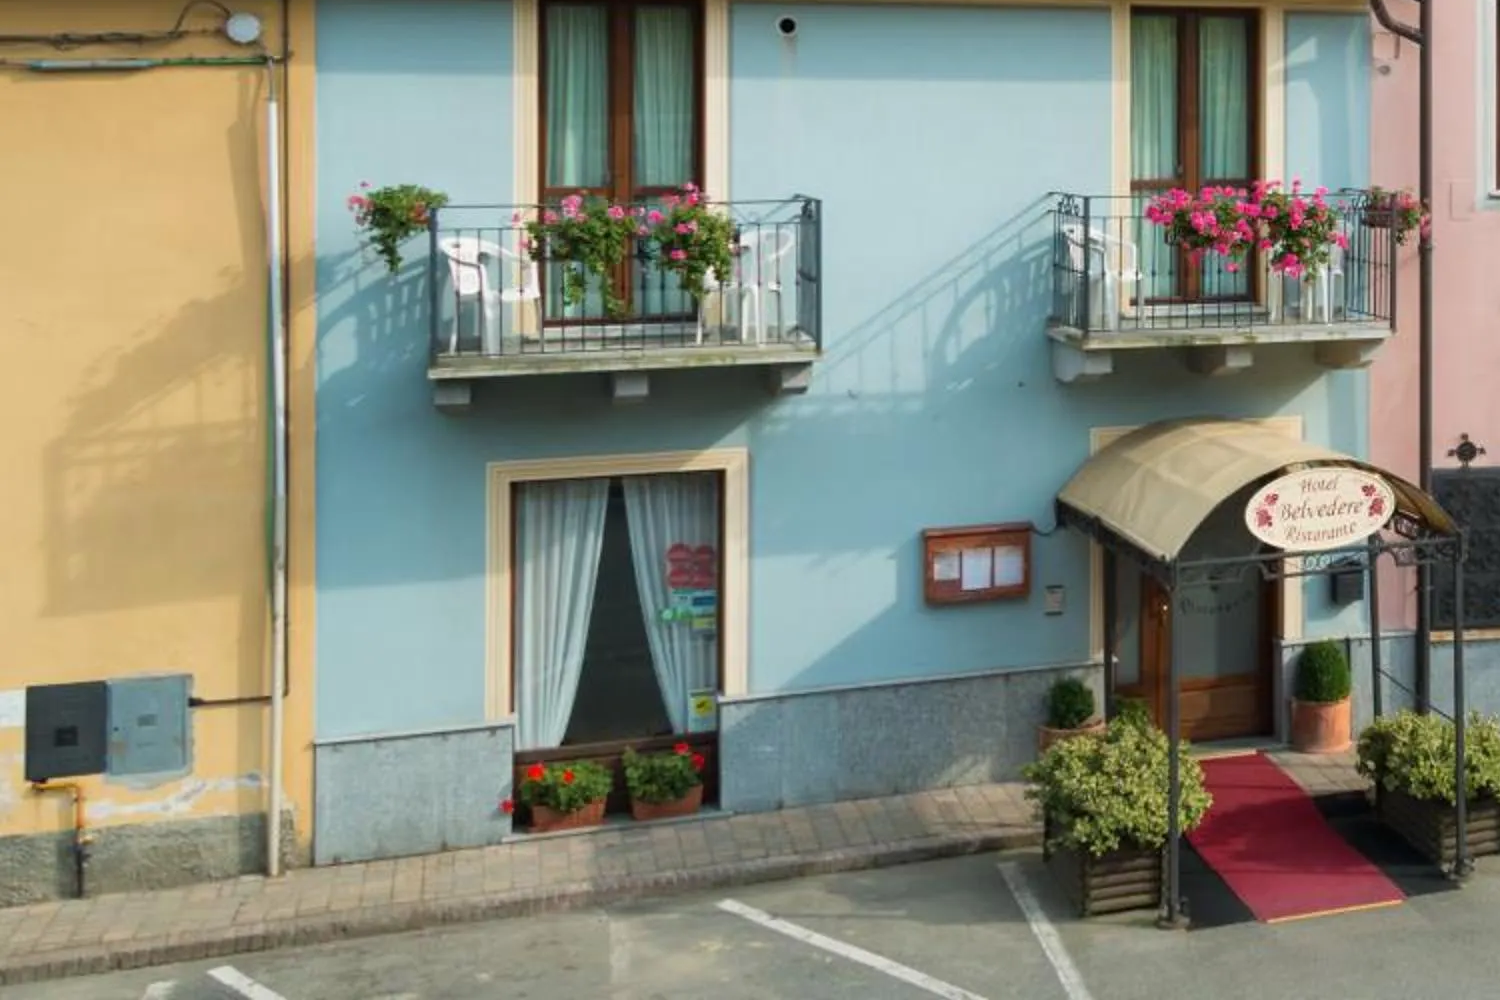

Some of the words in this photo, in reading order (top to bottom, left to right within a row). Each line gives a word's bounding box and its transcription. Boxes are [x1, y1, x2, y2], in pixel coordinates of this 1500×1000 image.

[1301, 476, 1338, 493] Hotel
[1281, 495, 1364, 521] Belvedere
[1284, 521, 1357, 543] Ristorante
